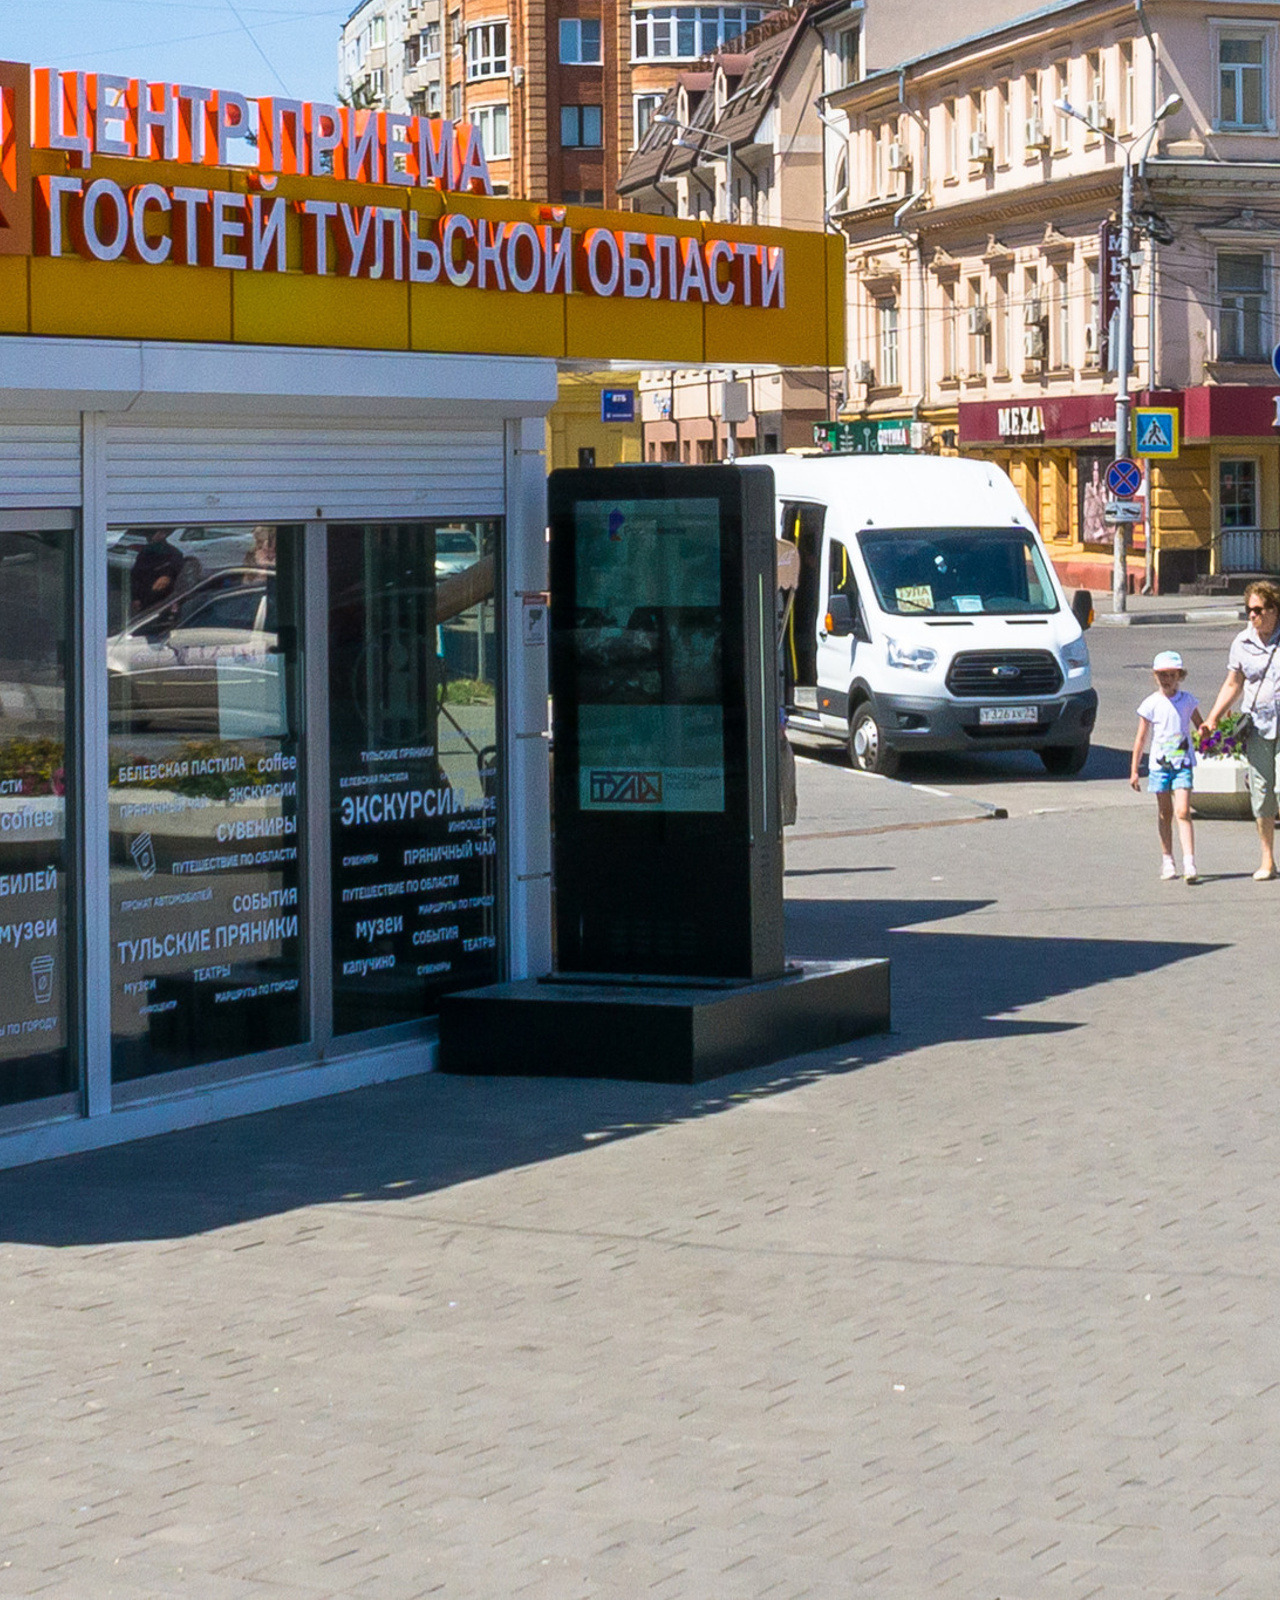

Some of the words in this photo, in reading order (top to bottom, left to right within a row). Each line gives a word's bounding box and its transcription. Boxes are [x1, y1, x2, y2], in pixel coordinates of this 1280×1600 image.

[42, 68, 249, 169] ЦЕНТР
[262, 97, 493, 195] ПРИЕМА
[48, 174, 287, 272] ГОСТЕЙ
[304, 199, 572, 294] ТУЛЬСКОЙ
[586, 227, 786, 308] ОБЛАСТИ
[998, 406, 1046, 436] МЕХА
[118, 761, 189, 782] БЕЛЕВСКАЯ
[191, 756, 246, 775] ПАСТИЛА
[257, 752, 297, 773] coffee
[228, 782, 297, 802] ЭКСКУРСИИ
[1, 807, 54, 831] coffee
[340, 788, 466, 826] ЭКСКУРСИИ
[216, 815, 297, 843] СУВЕНИРЫ
[172, 854, 239, 875] ПУТЕШЕСТВИЕ
[240, 852, 255, 866] ПО
[255, 847, 297, 863] ОБЛАСТИ
[404, 840, 473, 866] ПРЯНИЧНЫЙ
[475, 836, 497, 857] ЧАЙ
[232, 887, 298, 913] СОБЫТИЯ
[342, 881, 405, 902] ПУТЕШЕСТВИЕ
[406, 879, 419, 892] ПО
[420, 874, 459, 891] ОБЛАСТИ
[117, 928, 211, 965] ТУЛЬСКИЕ
[215, 915, 298, 949] ПРЯНИКИ
[356, 915, 403, 943] музеи
[412, 925, 459, 946] СОБЫТИЯ
[463, 935, 496, 951] ТЕАТРЫ
[193, 963, 231, 983] ТЕАТРЫ
[343, 954, 396, 977] капучино
[123, 978, 157, 997] музеи
